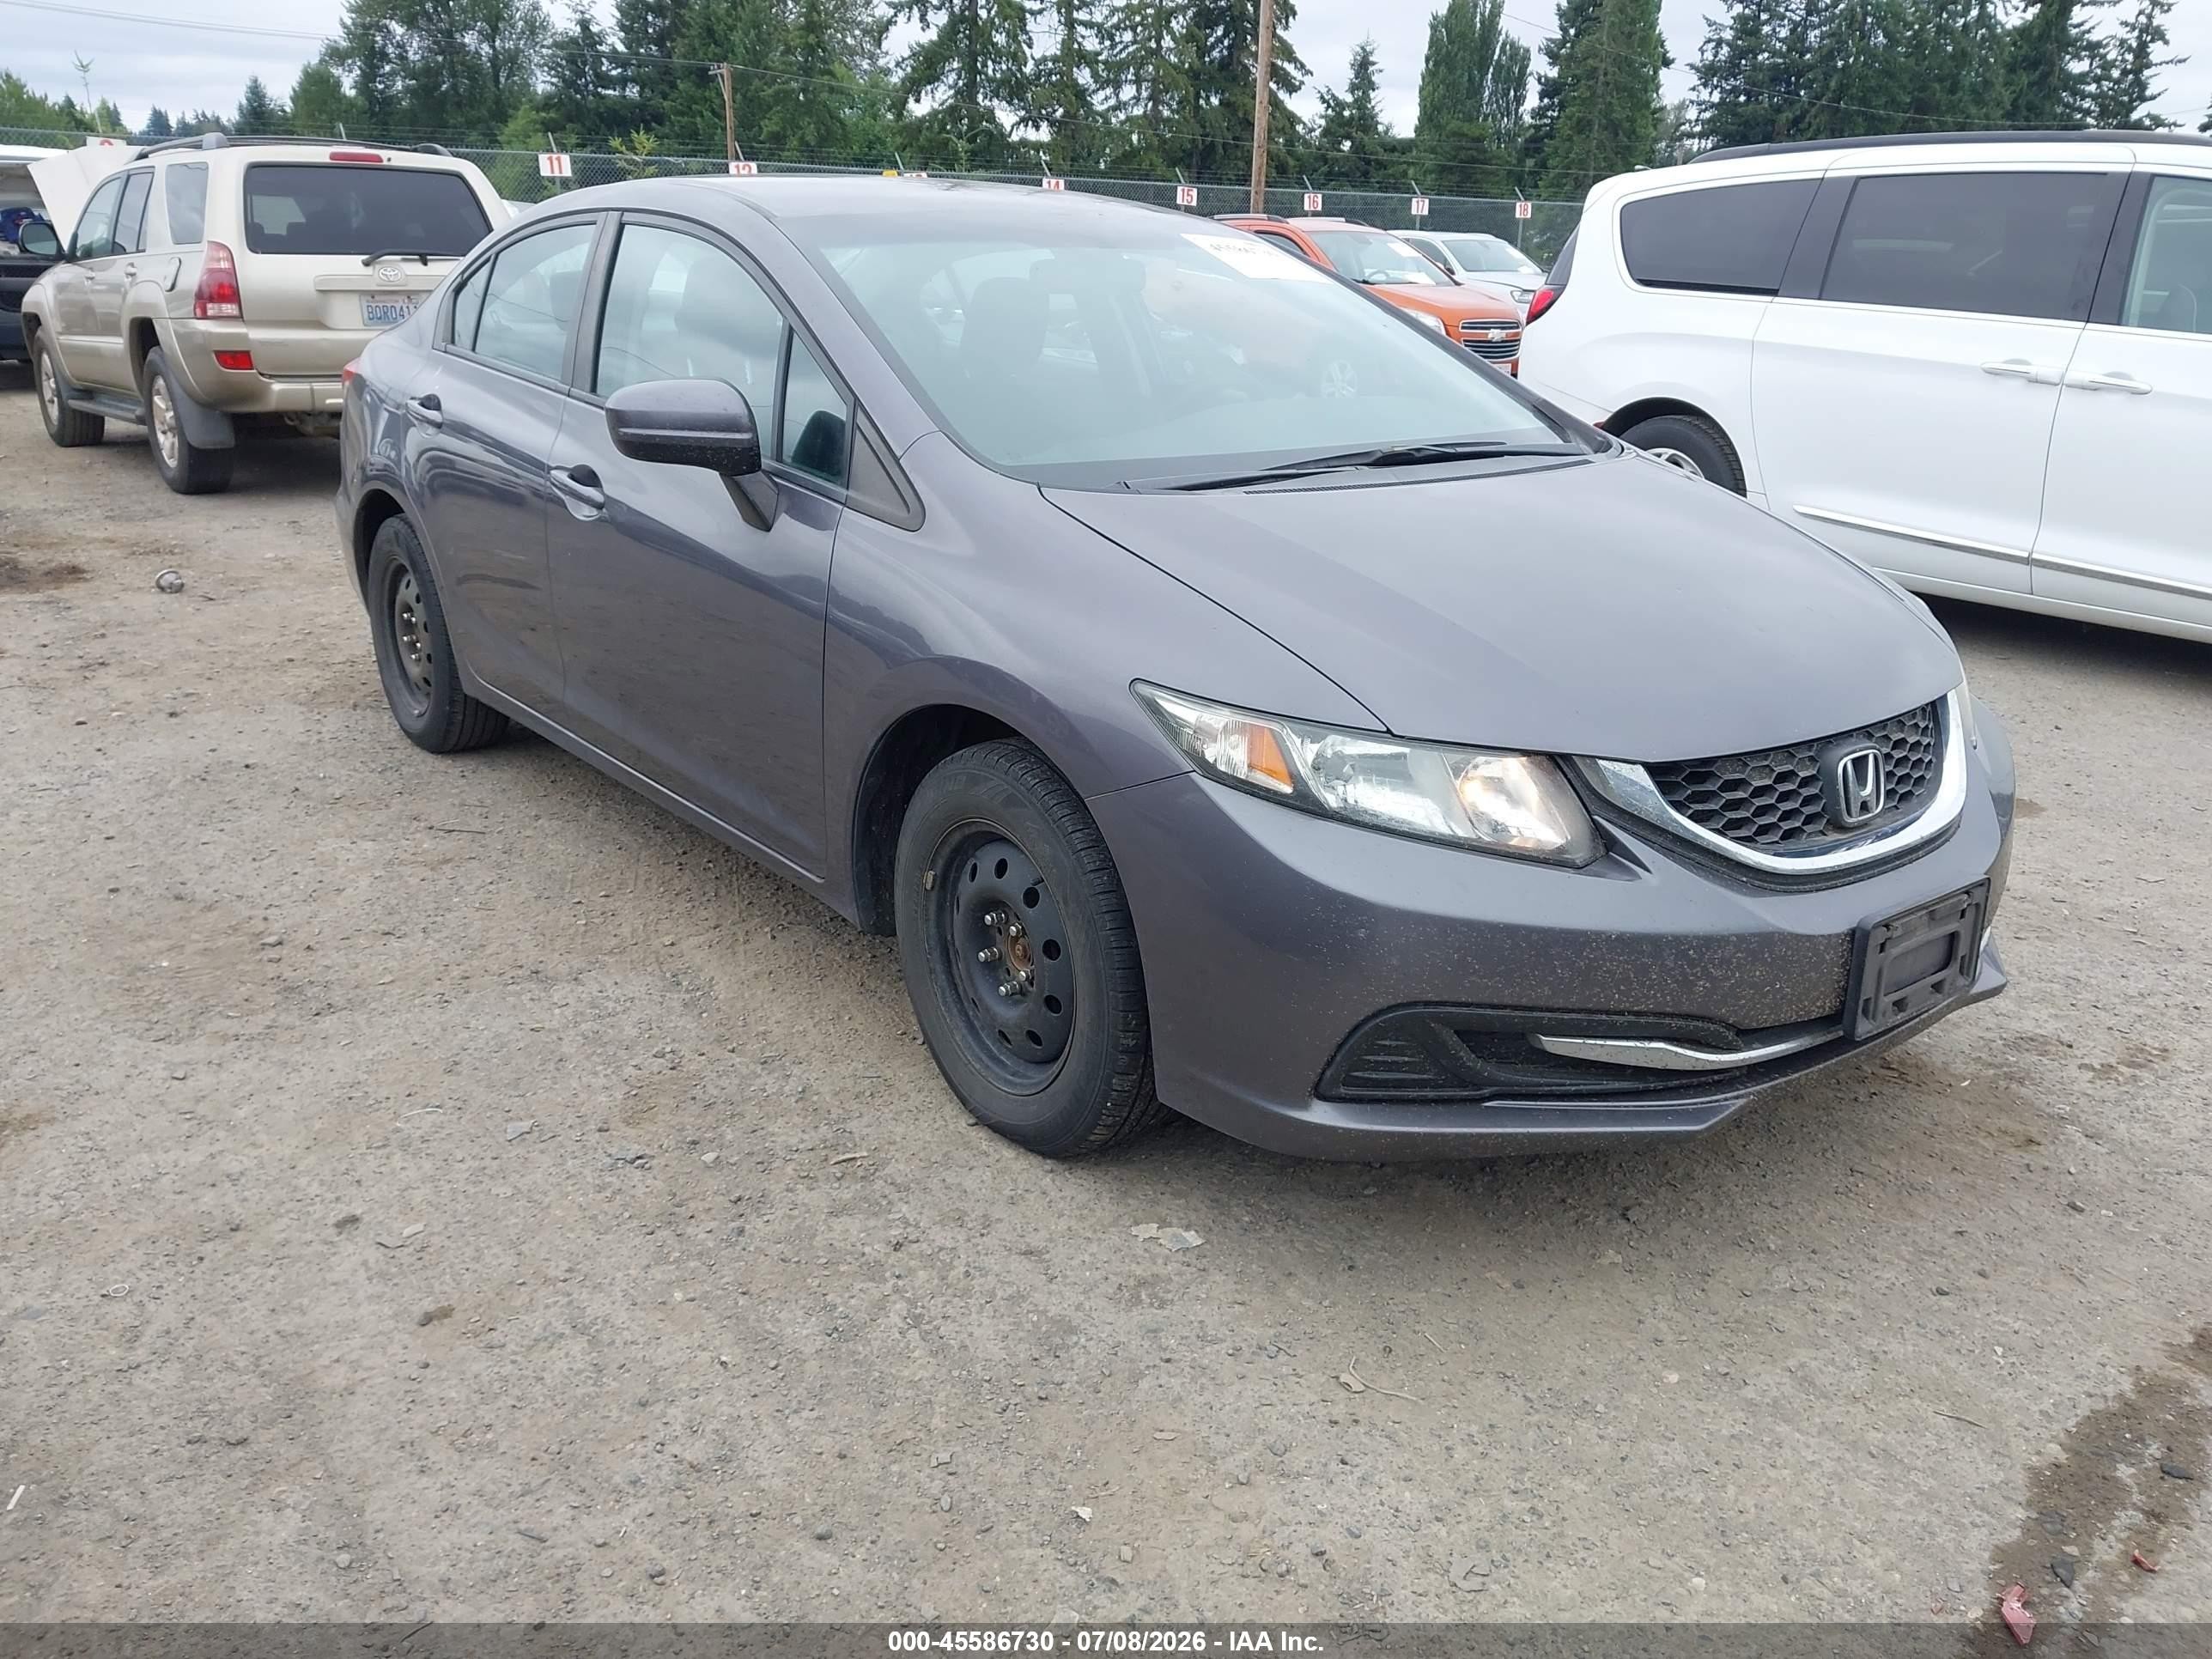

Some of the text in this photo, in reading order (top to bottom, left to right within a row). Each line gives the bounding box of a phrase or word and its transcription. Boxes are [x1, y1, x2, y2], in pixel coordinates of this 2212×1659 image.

[546, 155, 562, 174] 11
[1181, 188, 1194, 204] 15
[1307, 194, 1319, 210] 16
[1415, 199, 1425, 213] 17
[1519, 203, 1528, 216] 18
